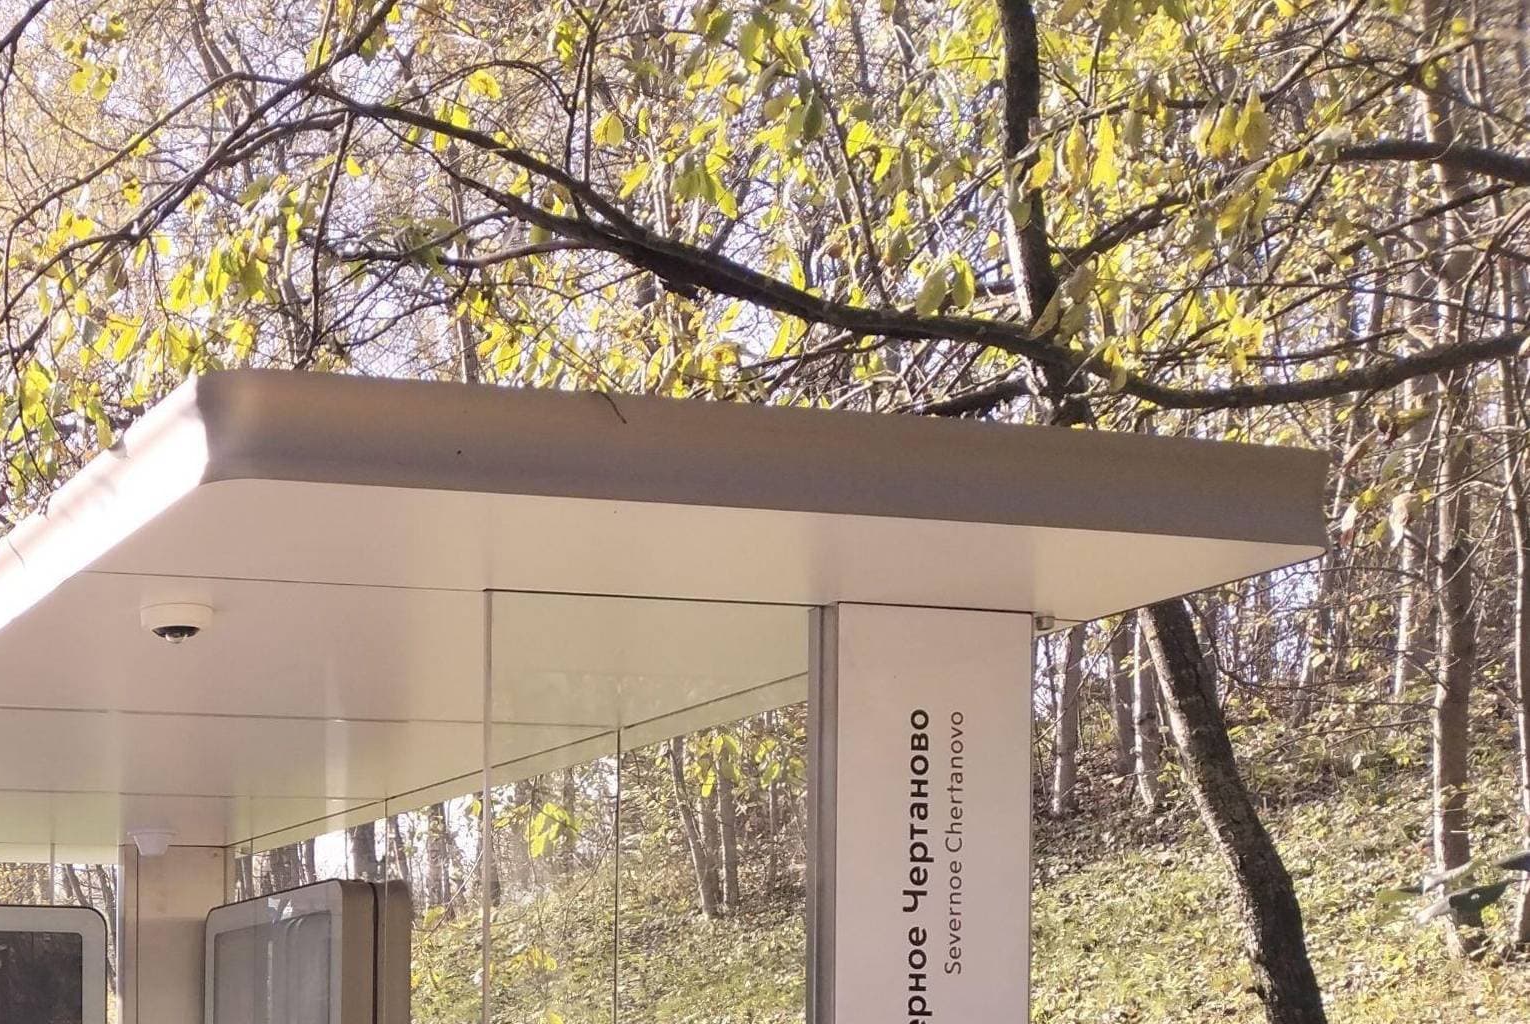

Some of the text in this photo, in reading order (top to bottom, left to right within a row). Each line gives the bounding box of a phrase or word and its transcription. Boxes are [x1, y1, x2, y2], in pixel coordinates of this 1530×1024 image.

[902, 709, 935, 913] Чертаново
[944, 711, 964, 975] Severnoe Chertanovo
